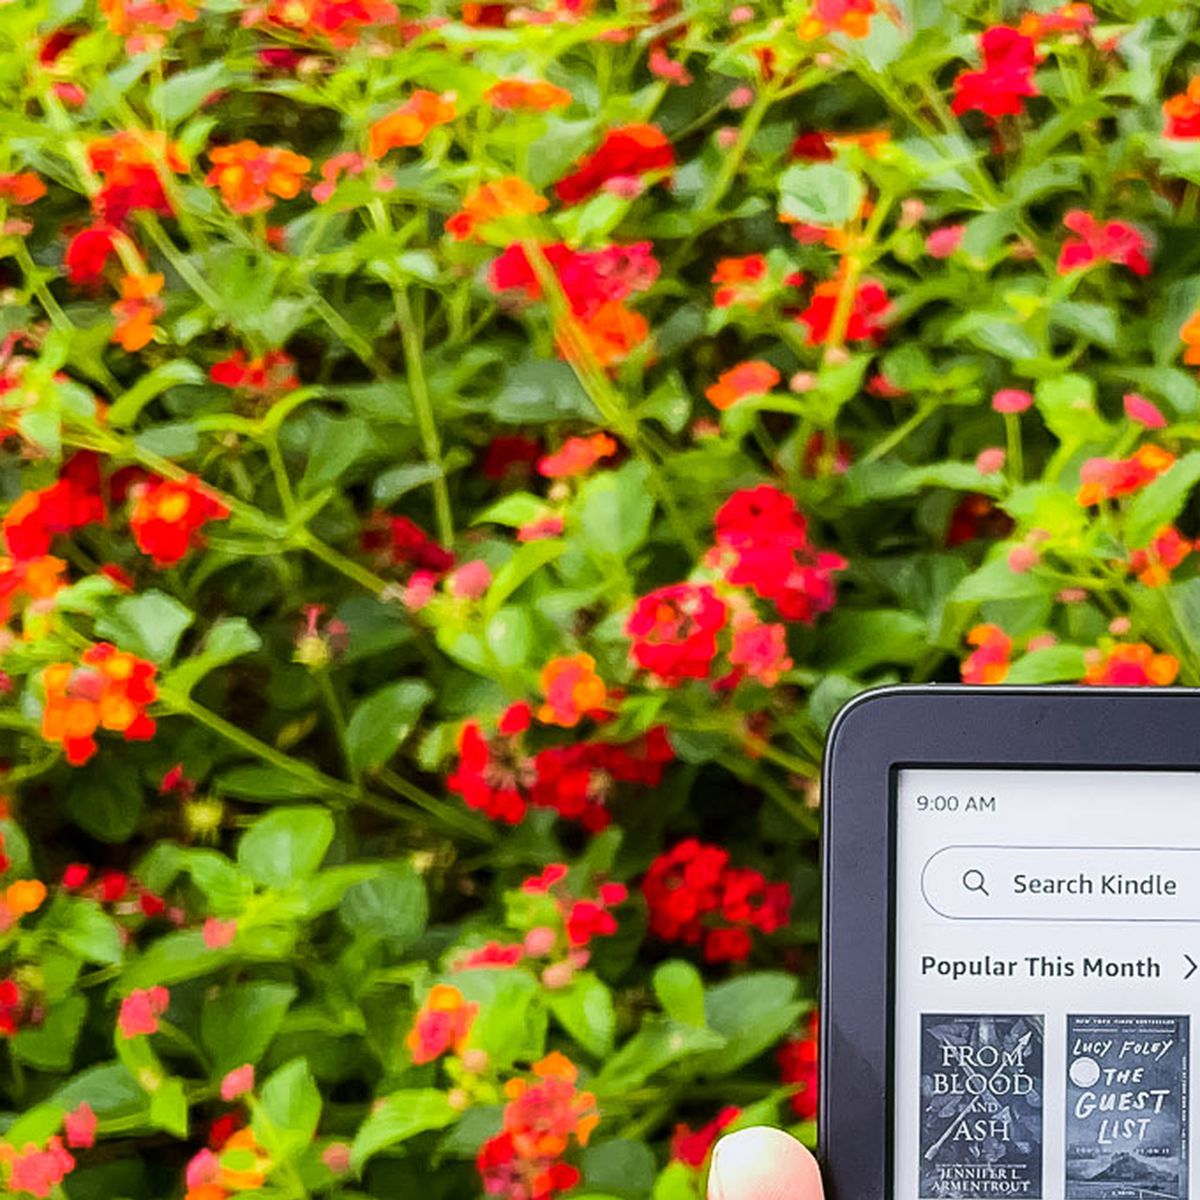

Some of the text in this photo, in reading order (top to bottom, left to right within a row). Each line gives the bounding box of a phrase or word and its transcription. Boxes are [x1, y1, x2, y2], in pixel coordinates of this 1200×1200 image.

[916, 796, 996, 813] 9:00 AM
[1013, 873, 1177, 896] Search Kindle
[921, 955, 1161, 980] Popular This Month
[942, 1045, 1025, 1068] FROM
[1073, 1038, 1174, 1062] LUCY FOLEY
[933, 1073, 1033, 1096] BLOOD
[1103, 1068, 1145, 1086] THE
[970, 1102, 999, 1113] AND
[1074, 1090, 1171, 1120] GUEST
[953, 1120, 1010, 1142] ASH
[1098, 1118, 1151, 1145] LIST
[932, 1180, 1031, 1192] ARMENTROUT
